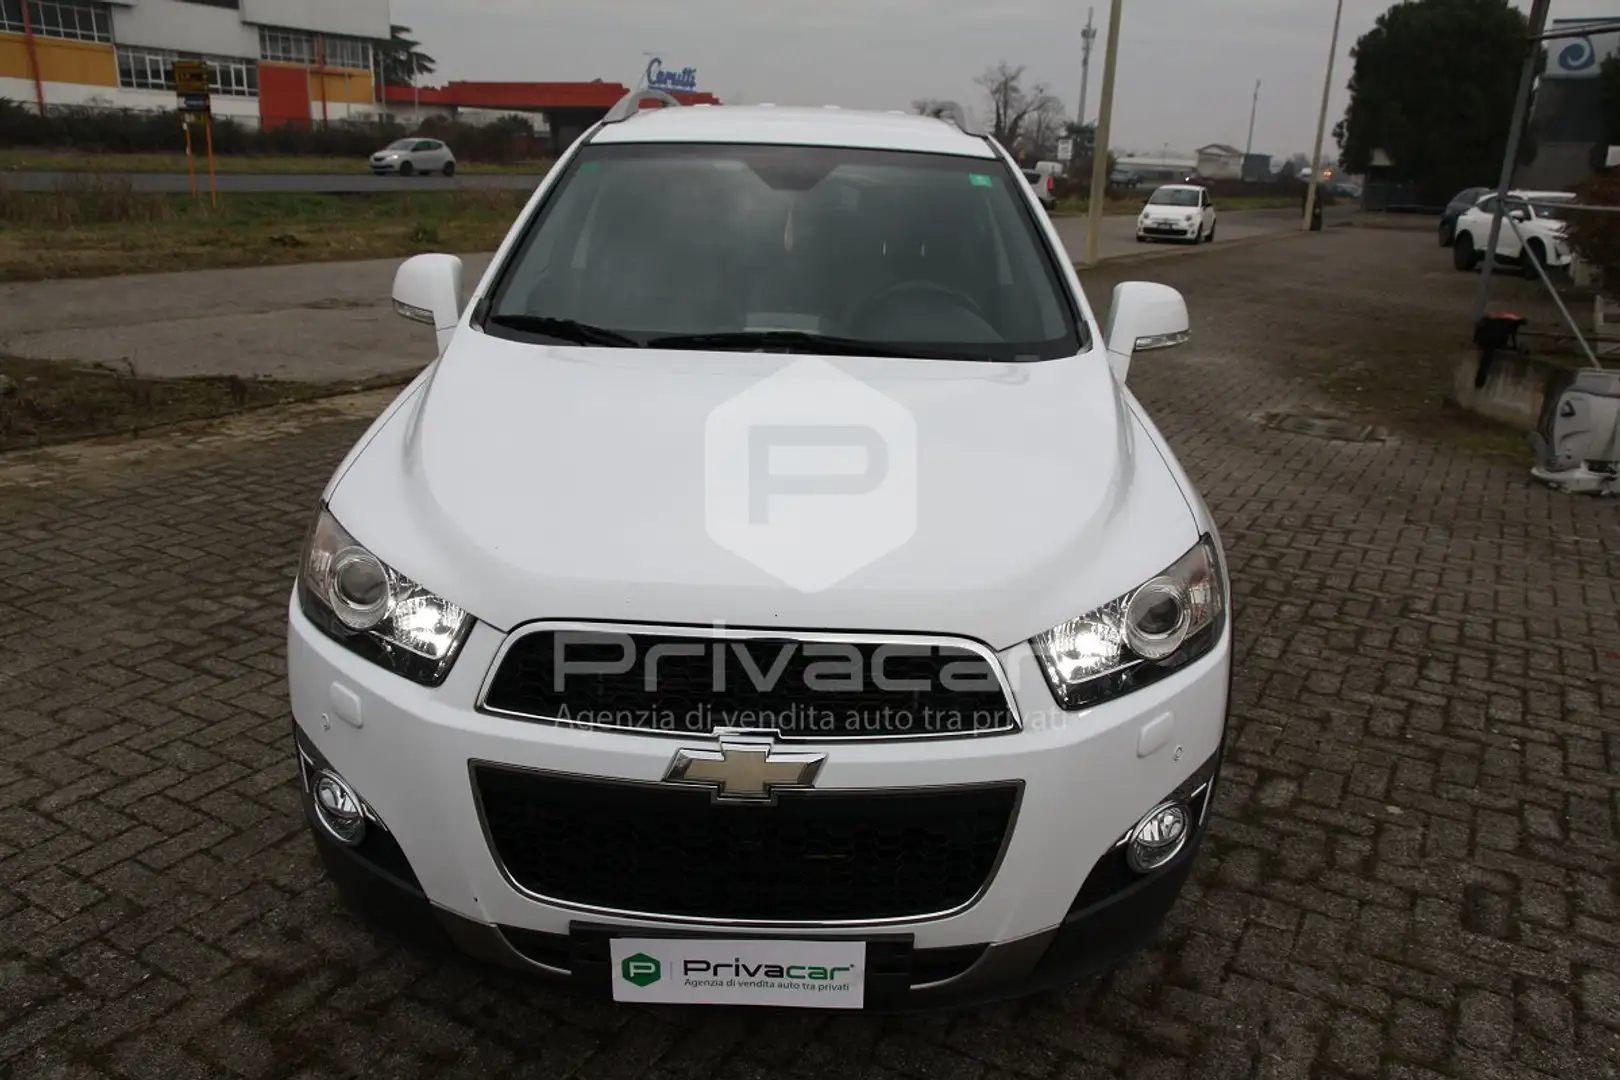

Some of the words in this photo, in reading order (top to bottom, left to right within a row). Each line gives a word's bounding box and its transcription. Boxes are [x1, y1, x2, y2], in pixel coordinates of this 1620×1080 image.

[684, 979, 723, 988] Agenzia
[726, 979, 736, 987] di
[738, 980, 774, 989] vendita
[778, 981, 800, 990] auto
[818, 983, 850, 992] privati
